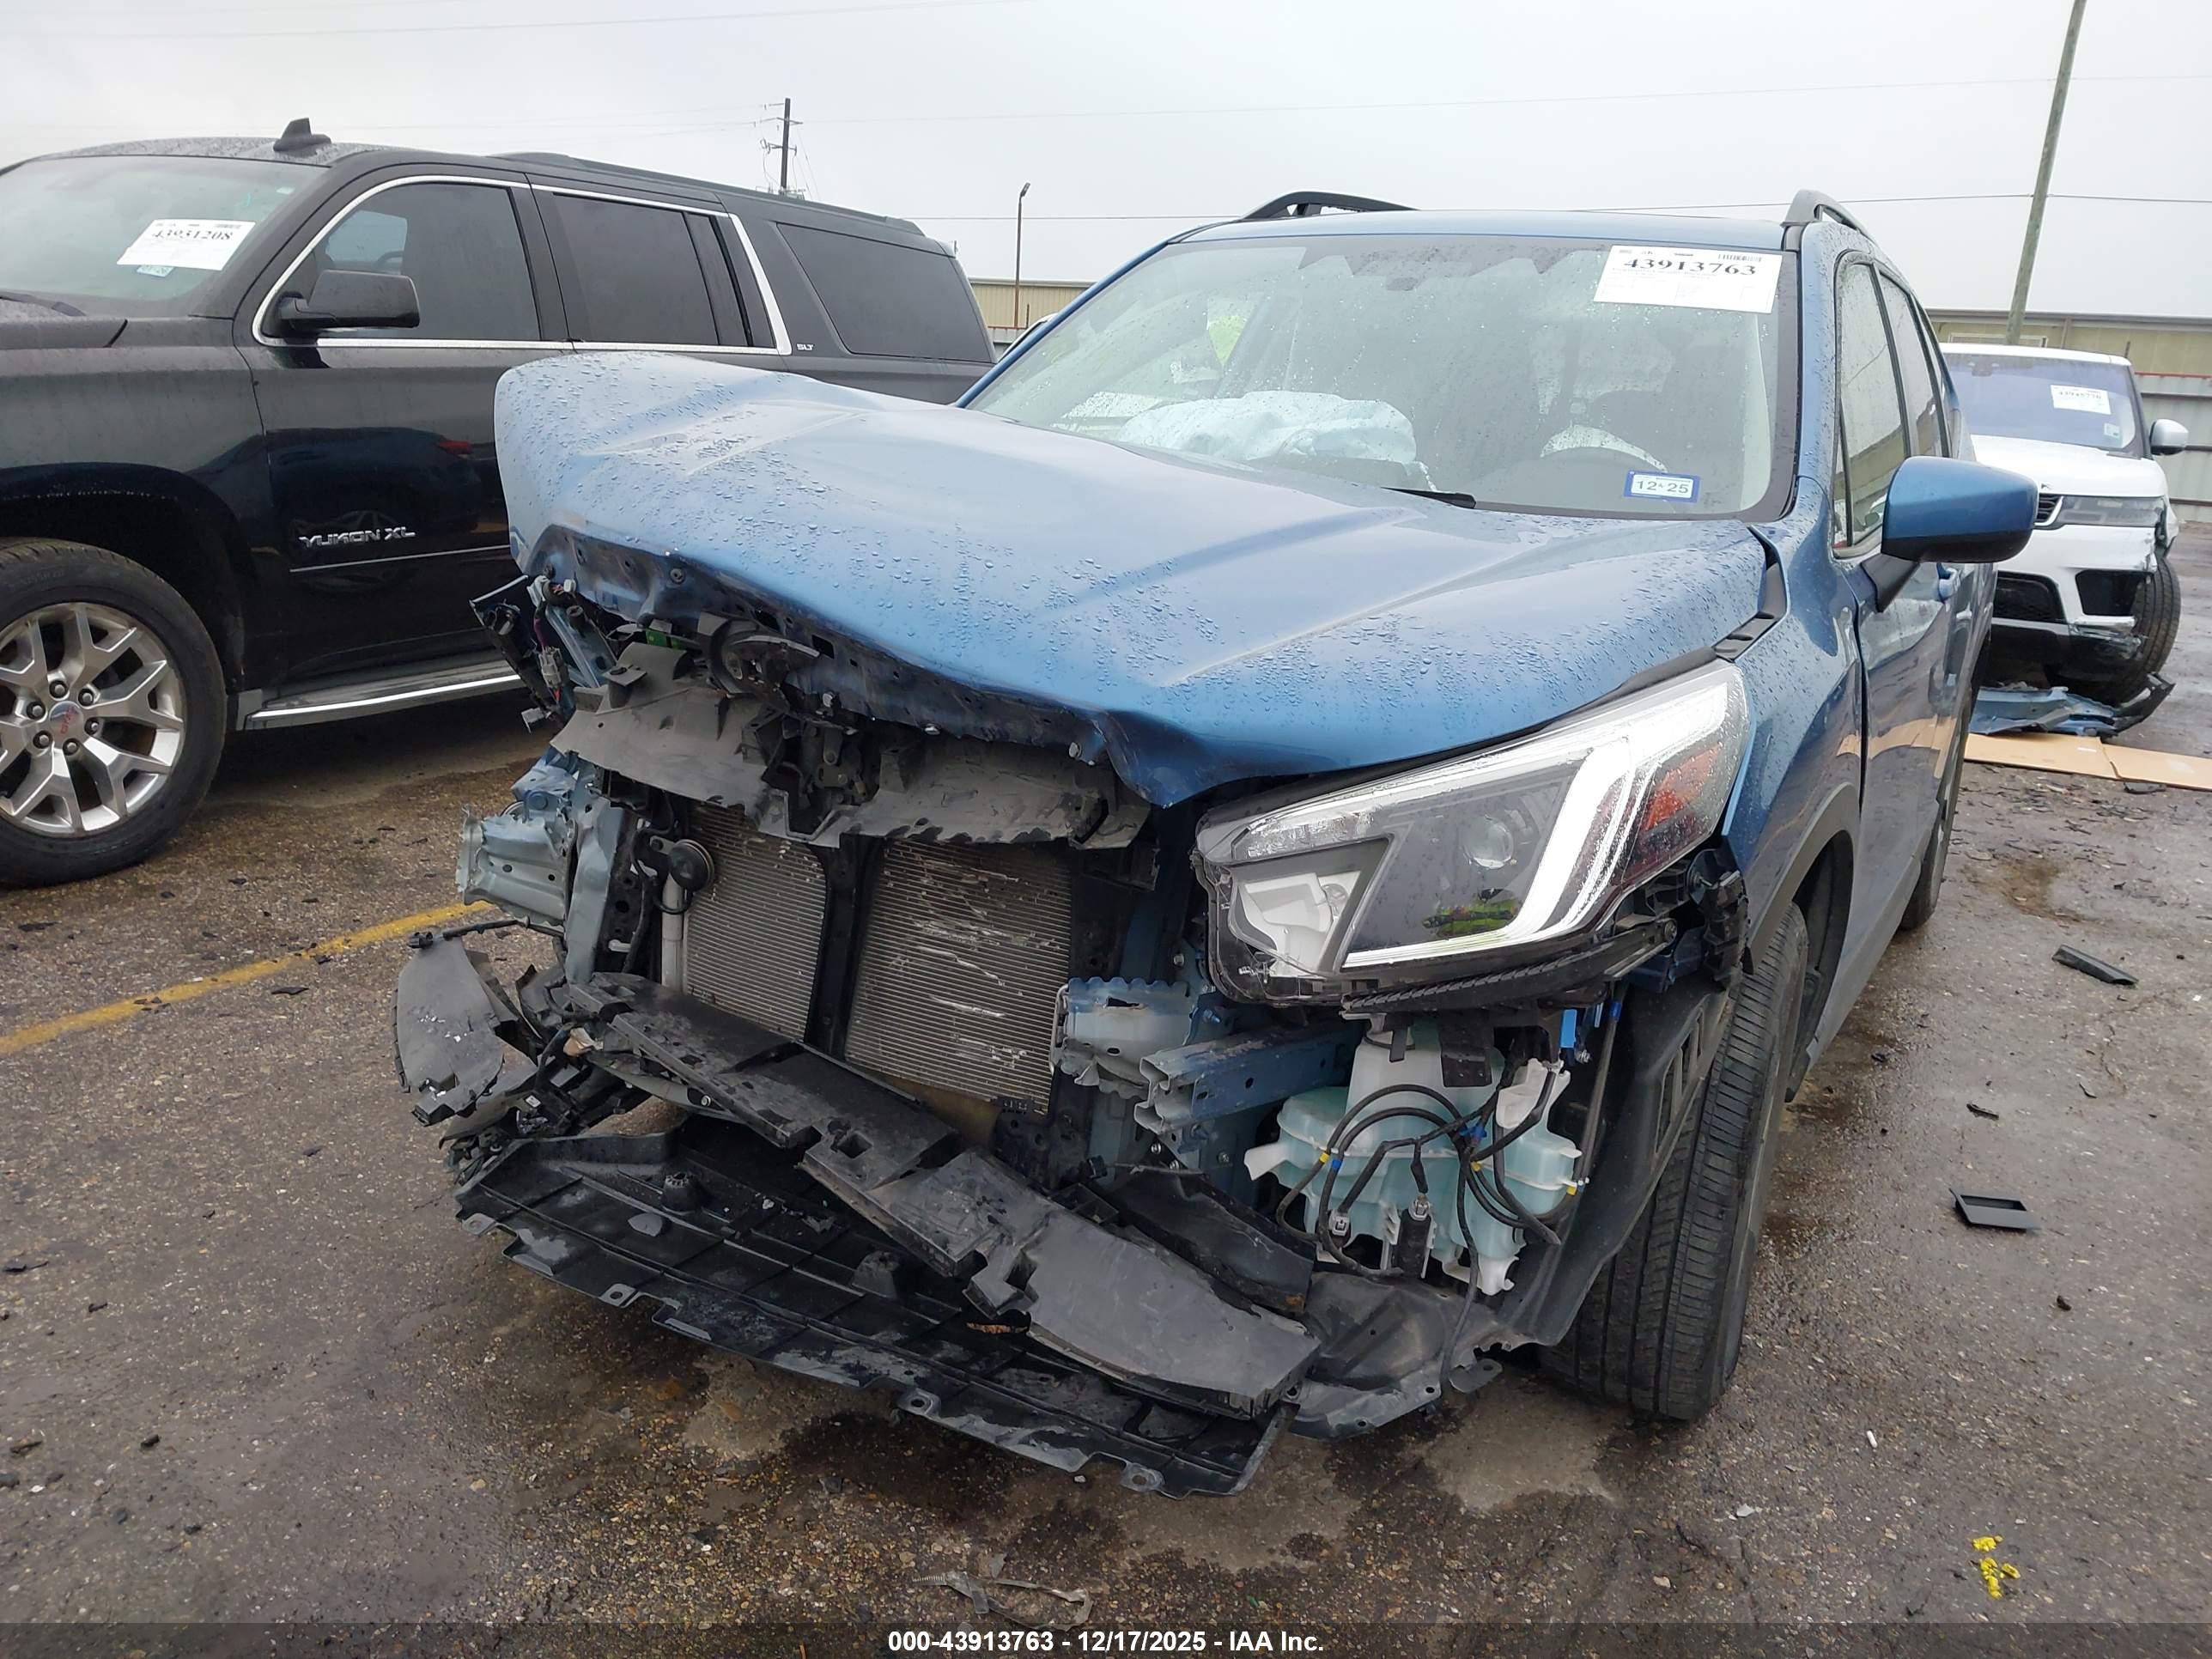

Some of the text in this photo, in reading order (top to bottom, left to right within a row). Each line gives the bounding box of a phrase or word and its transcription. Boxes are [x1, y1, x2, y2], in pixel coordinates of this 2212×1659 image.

[1624, 258, 1757, 276] 43913763
[298, 526, 416, 548] YUKON XL
